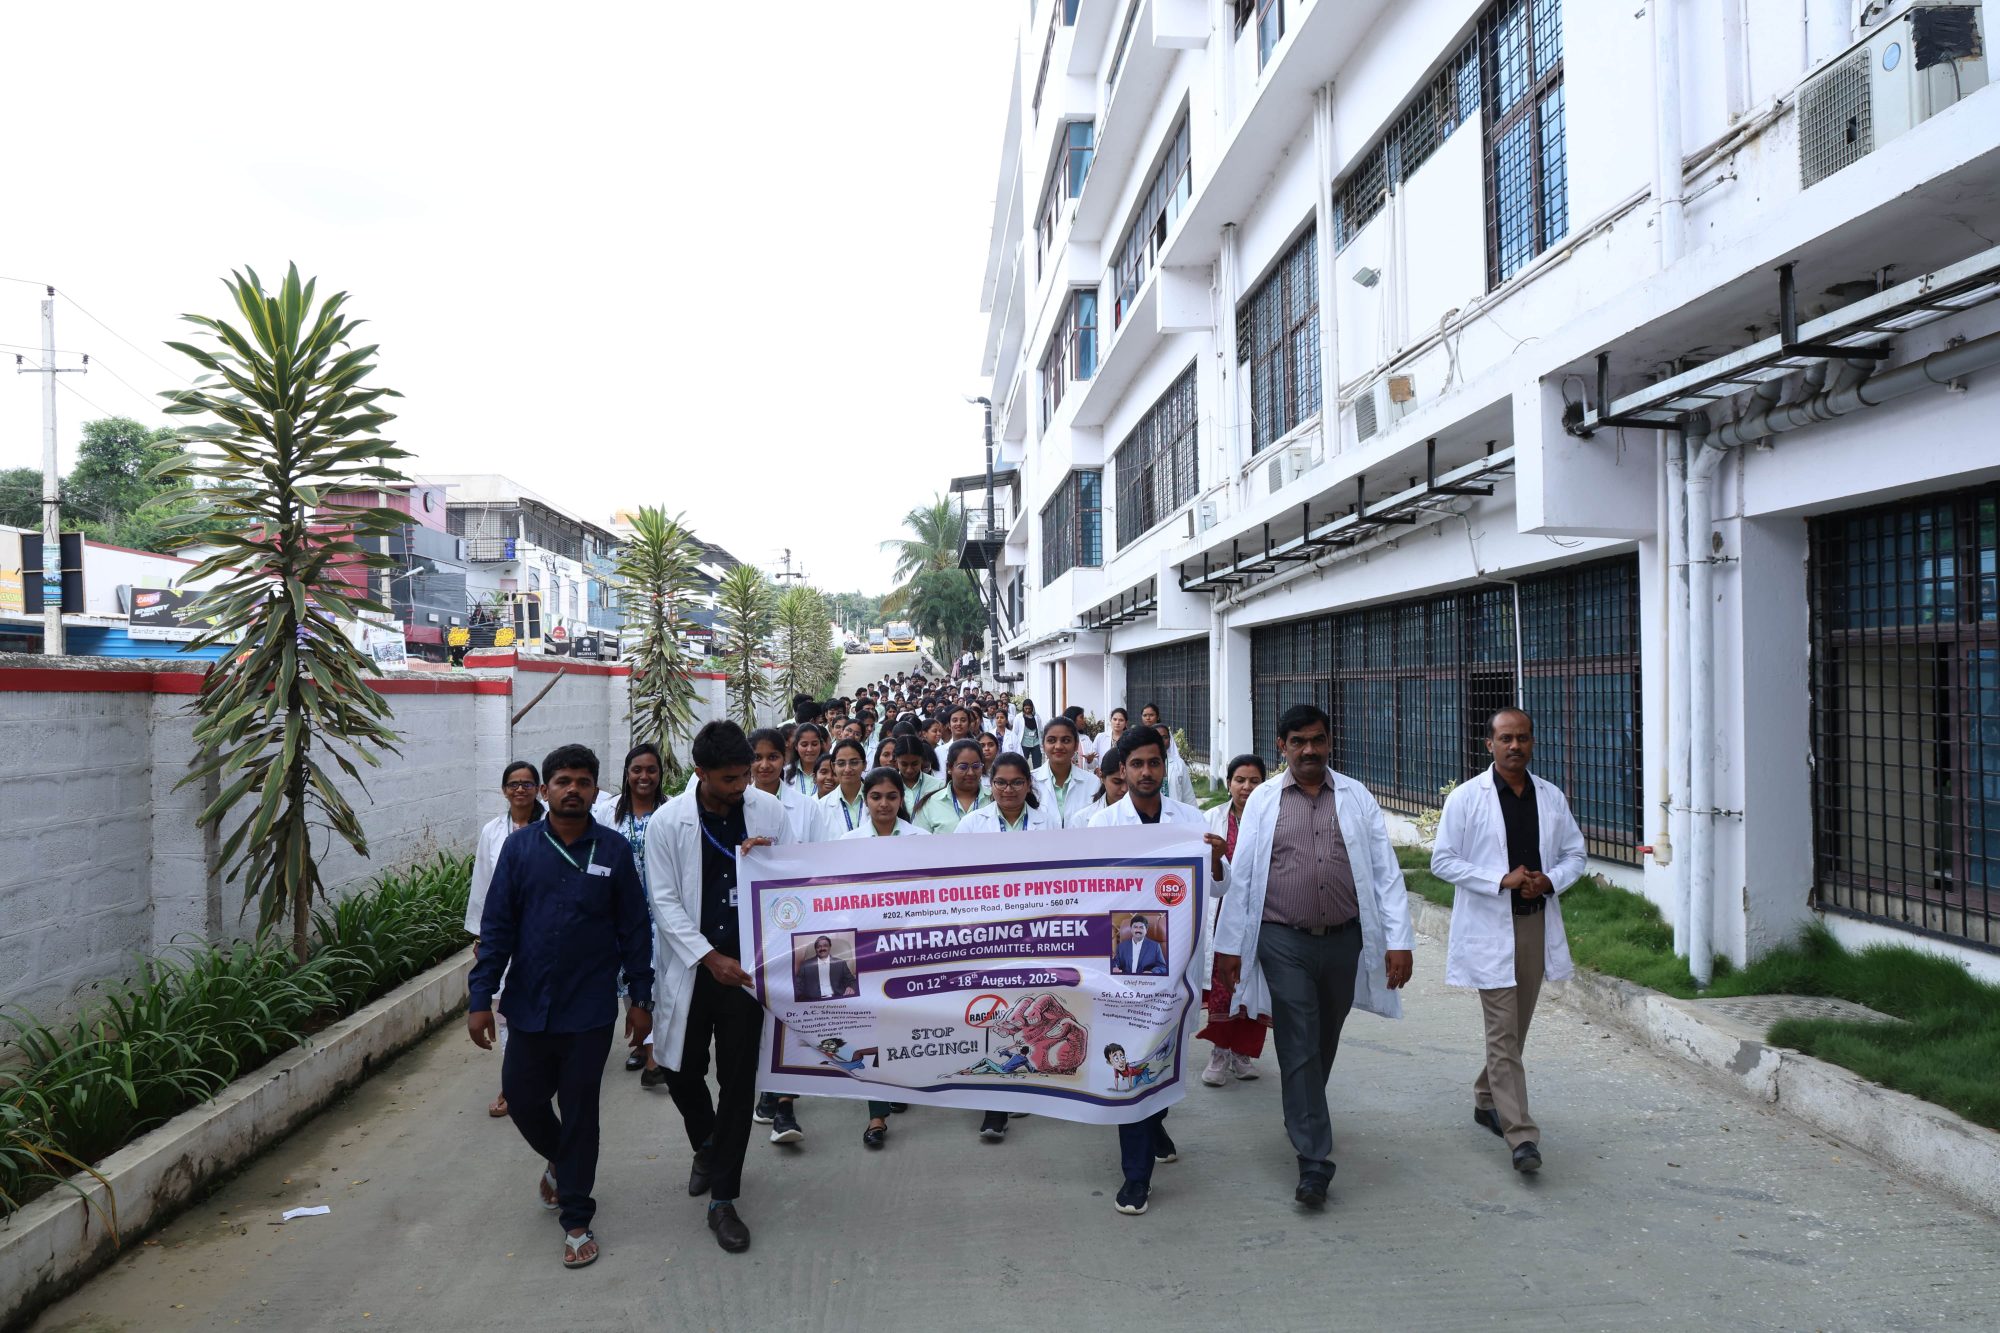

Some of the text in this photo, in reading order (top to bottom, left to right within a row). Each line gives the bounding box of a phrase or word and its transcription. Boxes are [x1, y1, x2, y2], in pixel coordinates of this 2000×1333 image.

[813, 889, 935, 912] RAJARAJESWARI
[939, 884, 1000, 903] COLLEGE
[1003, 883, 1021, 898] OF
[1024, 878, 1144, 896] PHYSIOTHERAPY
[1162, 884, 1180, 893] ISO
[883, 911, 903, 920] #202,
[905, 908, 949, 919] Kambipura,
[951, 905, 979, 915] Mysore
[980, 903, 1003, 913] Road,
[1005, 901, 1044, 912] Bengaluru
[1050, 899, 1064, 907] 560
[1066, 898, 1079, 906] 074
[876, 919, 1089, 953] ANTI-RAGGING WEEK
[891, 942, 1075, 965] ANTI-RAGGING COMMITTEE, RRMCH
[907, 980, 924, 992] On
[927, 974, 947, 989] 12th
[958, 973, 978, 987] 18th
[981, 974, 1026, 987] August,
[1029, 973, 1058, 984] 2025
[1115, 991, 1134, 999] A.C.S
[1135, 991, 1153, 999] Arun
[1127, 1008, 1152, 1018] President
[911, 1027, 955, 1041] STOP
[887, 1040, 979, 1061] RAGGING!!
